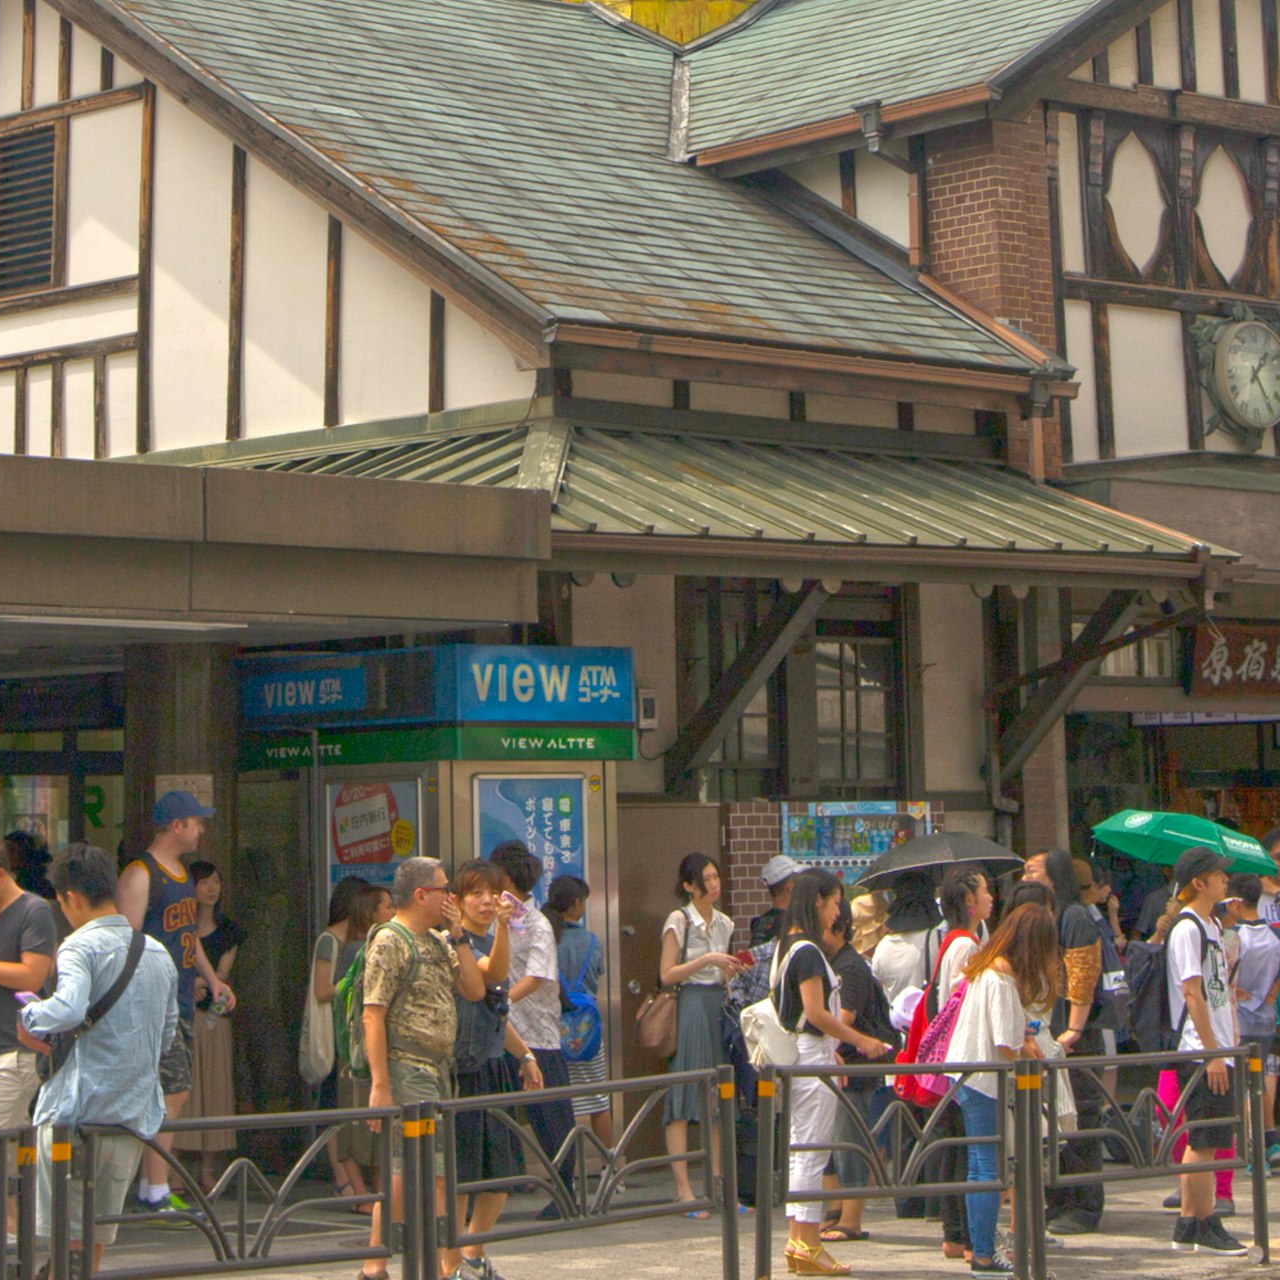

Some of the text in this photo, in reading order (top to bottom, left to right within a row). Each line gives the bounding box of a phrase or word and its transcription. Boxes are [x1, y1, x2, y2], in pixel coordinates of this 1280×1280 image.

[579, 665, 617, 687] ATM
[578, 687, 620, 704] コーナー
[266, 744, 342, 759] VIEW ATTE
[501, 737, 595, 750] VIEW ALTTE
[180, 932, 197, 969] 2
